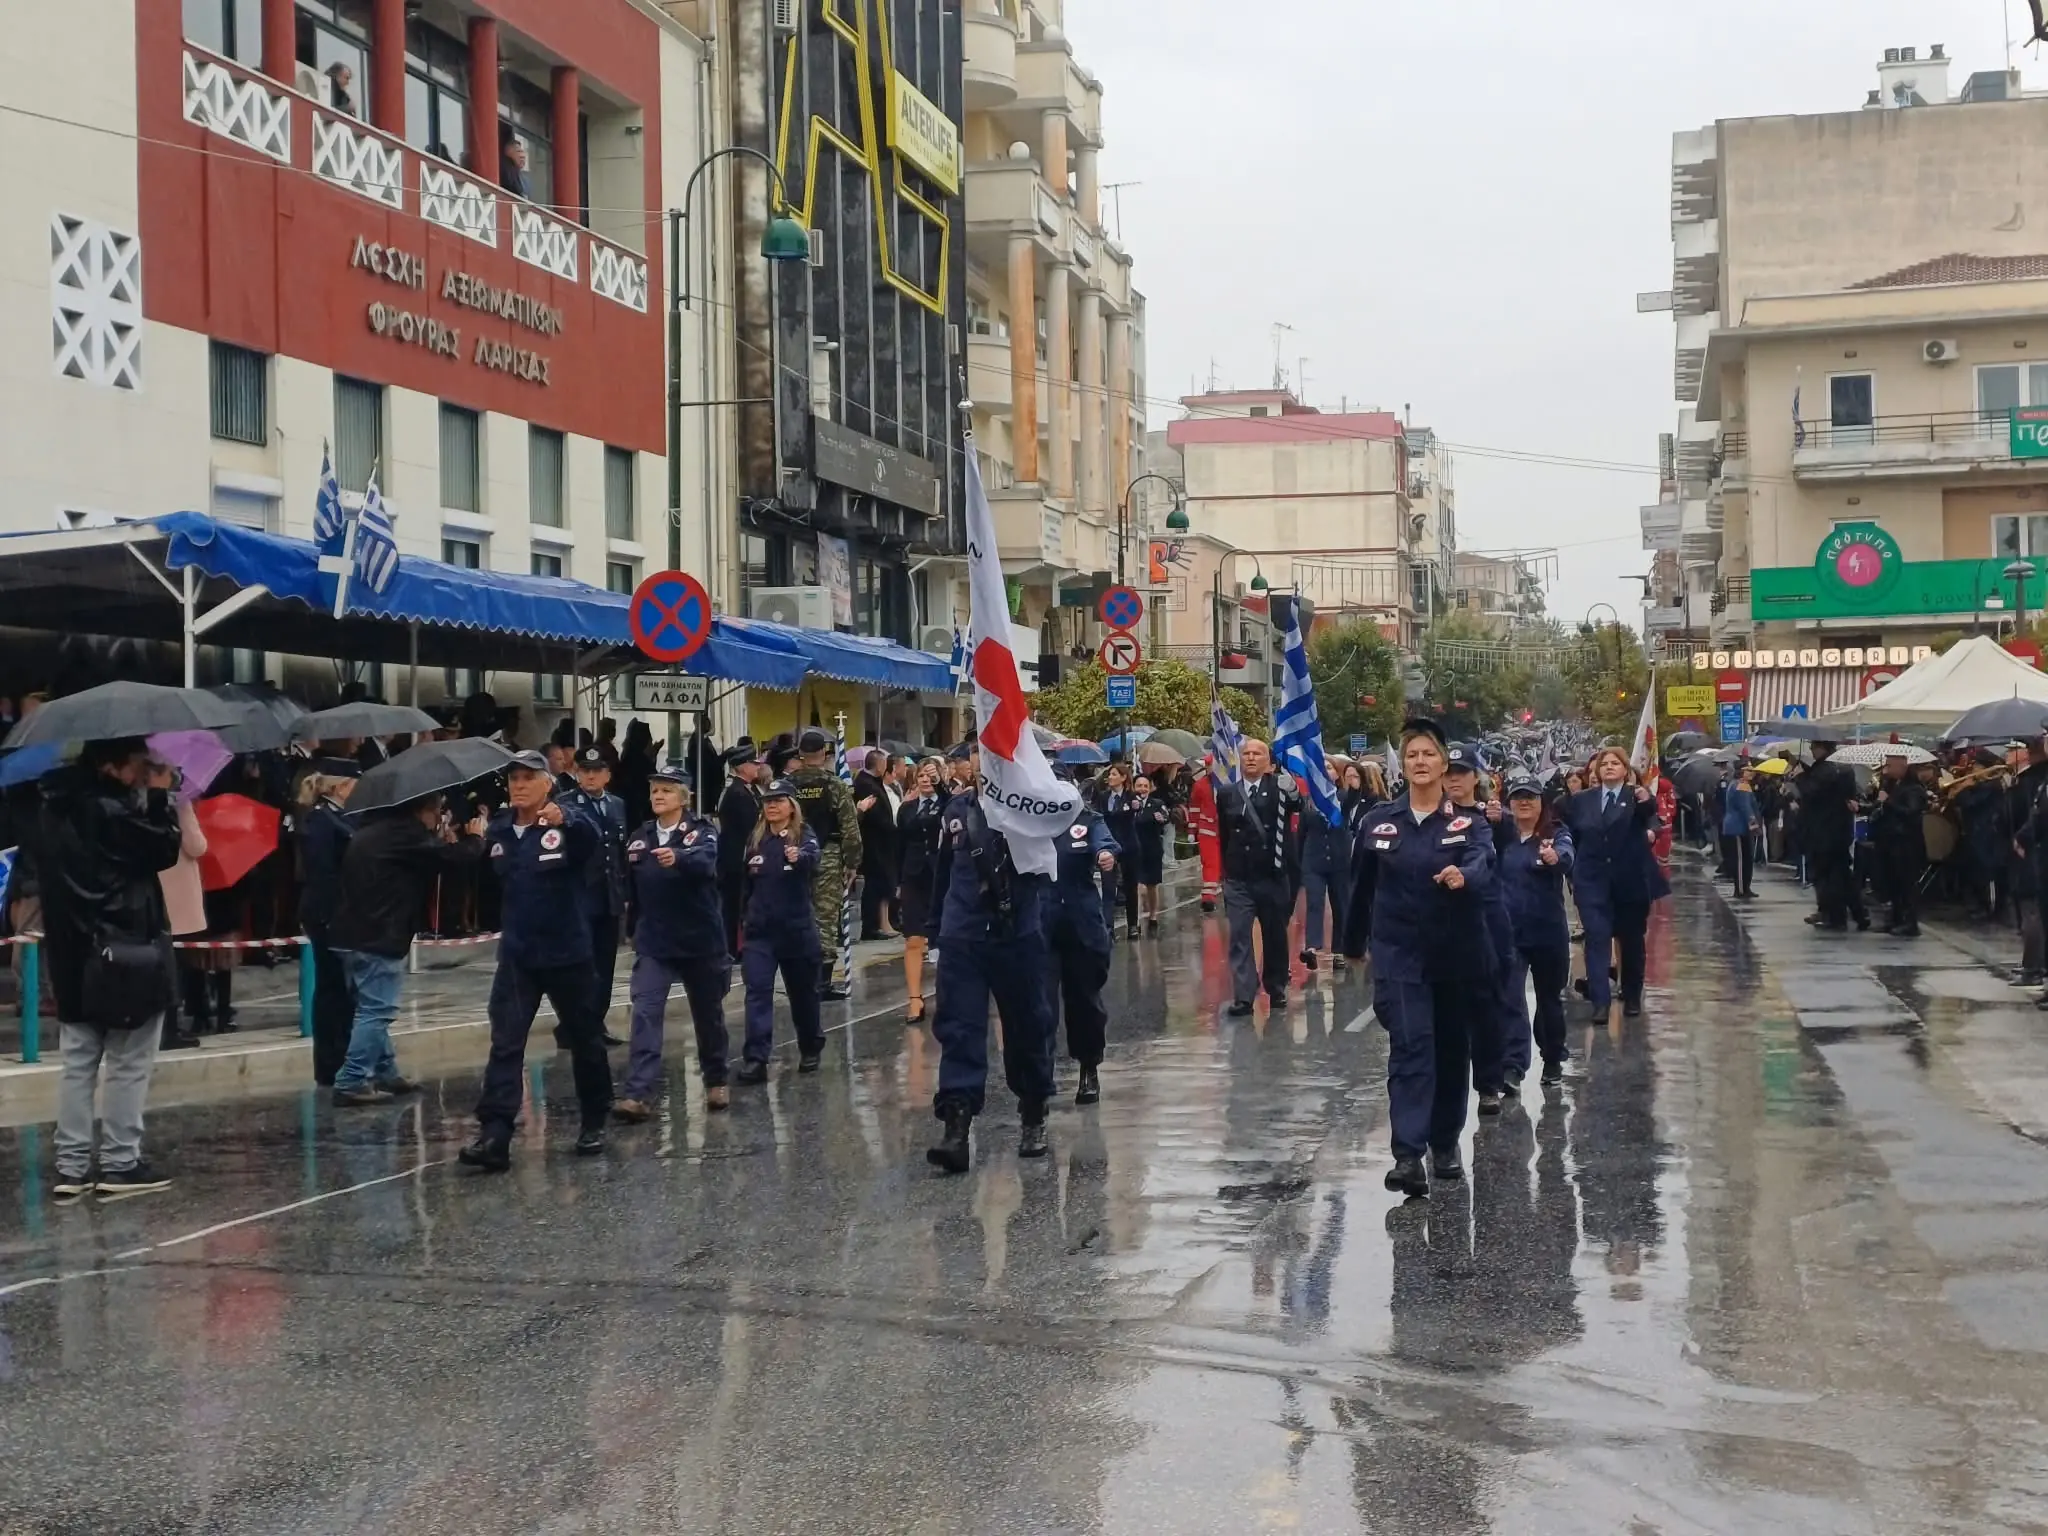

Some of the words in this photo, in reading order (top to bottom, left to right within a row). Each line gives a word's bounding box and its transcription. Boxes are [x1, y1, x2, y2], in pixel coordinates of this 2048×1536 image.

[901, 89, 953, 161] ALTERLIFE
[352, 234, 425, 290] ΛΕΣΧΗ
[442, 269, 563, 336] ΑΞΙΩΜΑΤΙΚΩΝ
[368, 301, 460, 360] ΦΡΟΥΡΑΣ
[474, 336, 549, 386] ΛΑΡΙΣΑΣ
